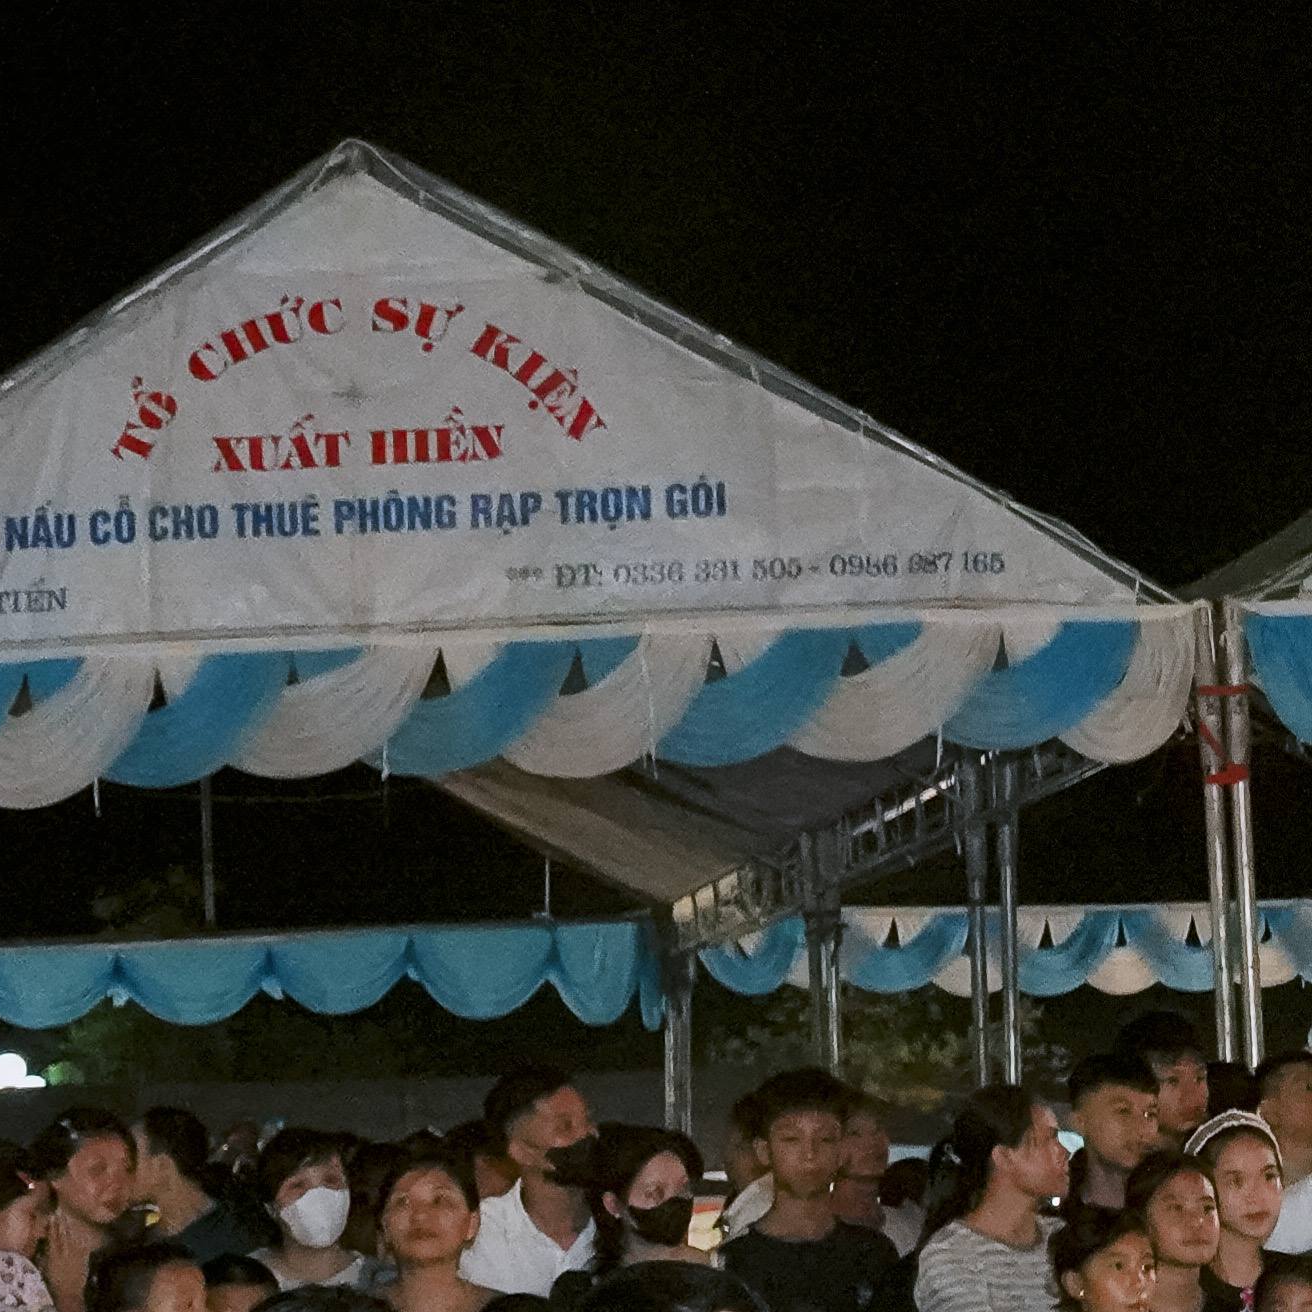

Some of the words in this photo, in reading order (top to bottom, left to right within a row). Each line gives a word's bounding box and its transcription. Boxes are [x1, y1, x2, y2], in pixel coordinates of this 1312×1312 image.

[188, 291, 346, 382] CHỨC
[371, 297, 465, 352] SỰ
[469, 324, 607, 441] KIỆN
[213, 412, 351, 473] XUẤT
[370, 404, 505, 466] HIỀN
[4, 500, 76, 551] NẤU
[148, 503, 219, 542] CHO
[231, 493, 322, 538] THUÊ
[334, 489, 458, 534] PHÔNG
[469, 491, 543, 535] RẠP
[554, 484, 652, 531] TRỌN
